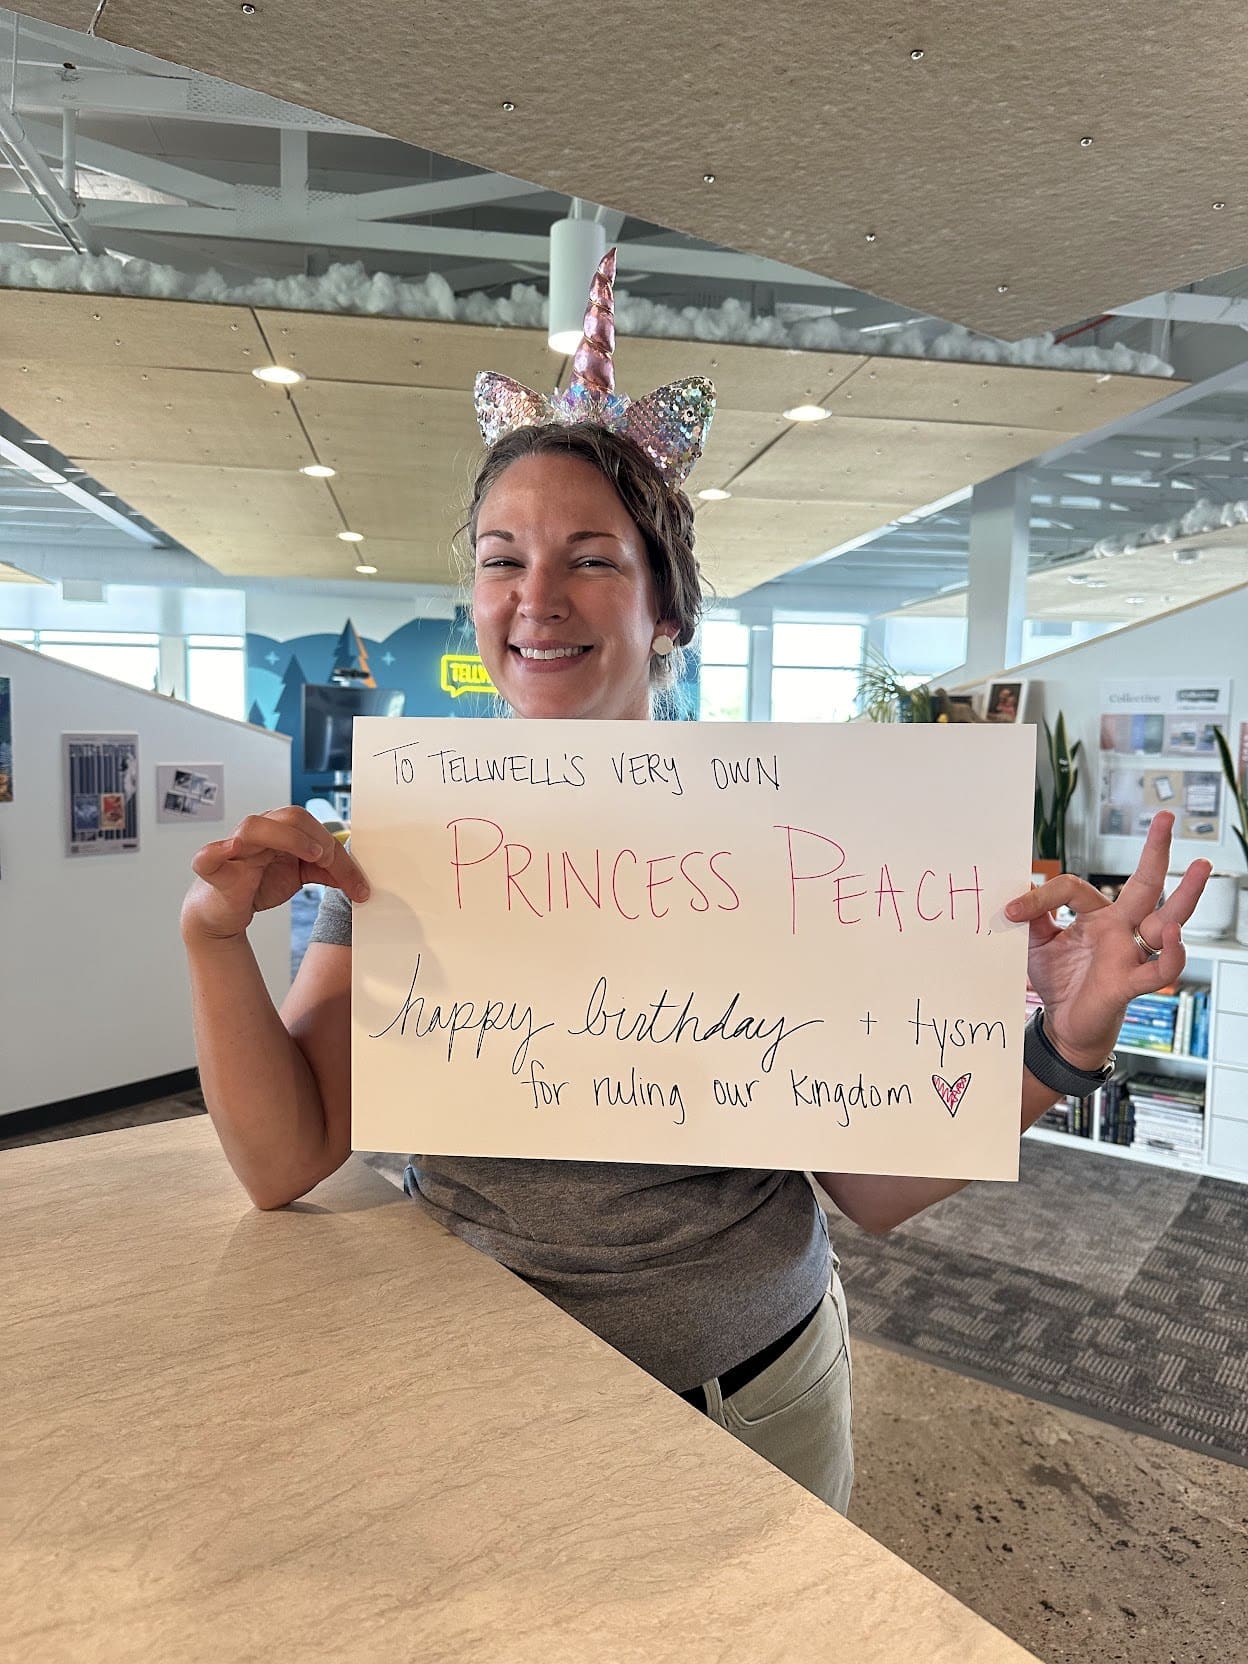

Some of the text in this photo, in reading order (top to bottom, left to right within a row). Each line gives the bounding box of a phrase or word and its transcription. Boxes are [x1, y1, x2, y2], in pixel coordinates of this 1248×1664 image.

[372, 741, 781, 796] TO TELLWELL'S VERY OWN
[446, 817, 740, 920] PRINCESS
[368, 953, 1006, 1075] happy birthday + tysm
[520, 1059, 570, 1109] for
[593, 1066, 686, 1126] ruling
[713, 1079, 760, 1108] our
